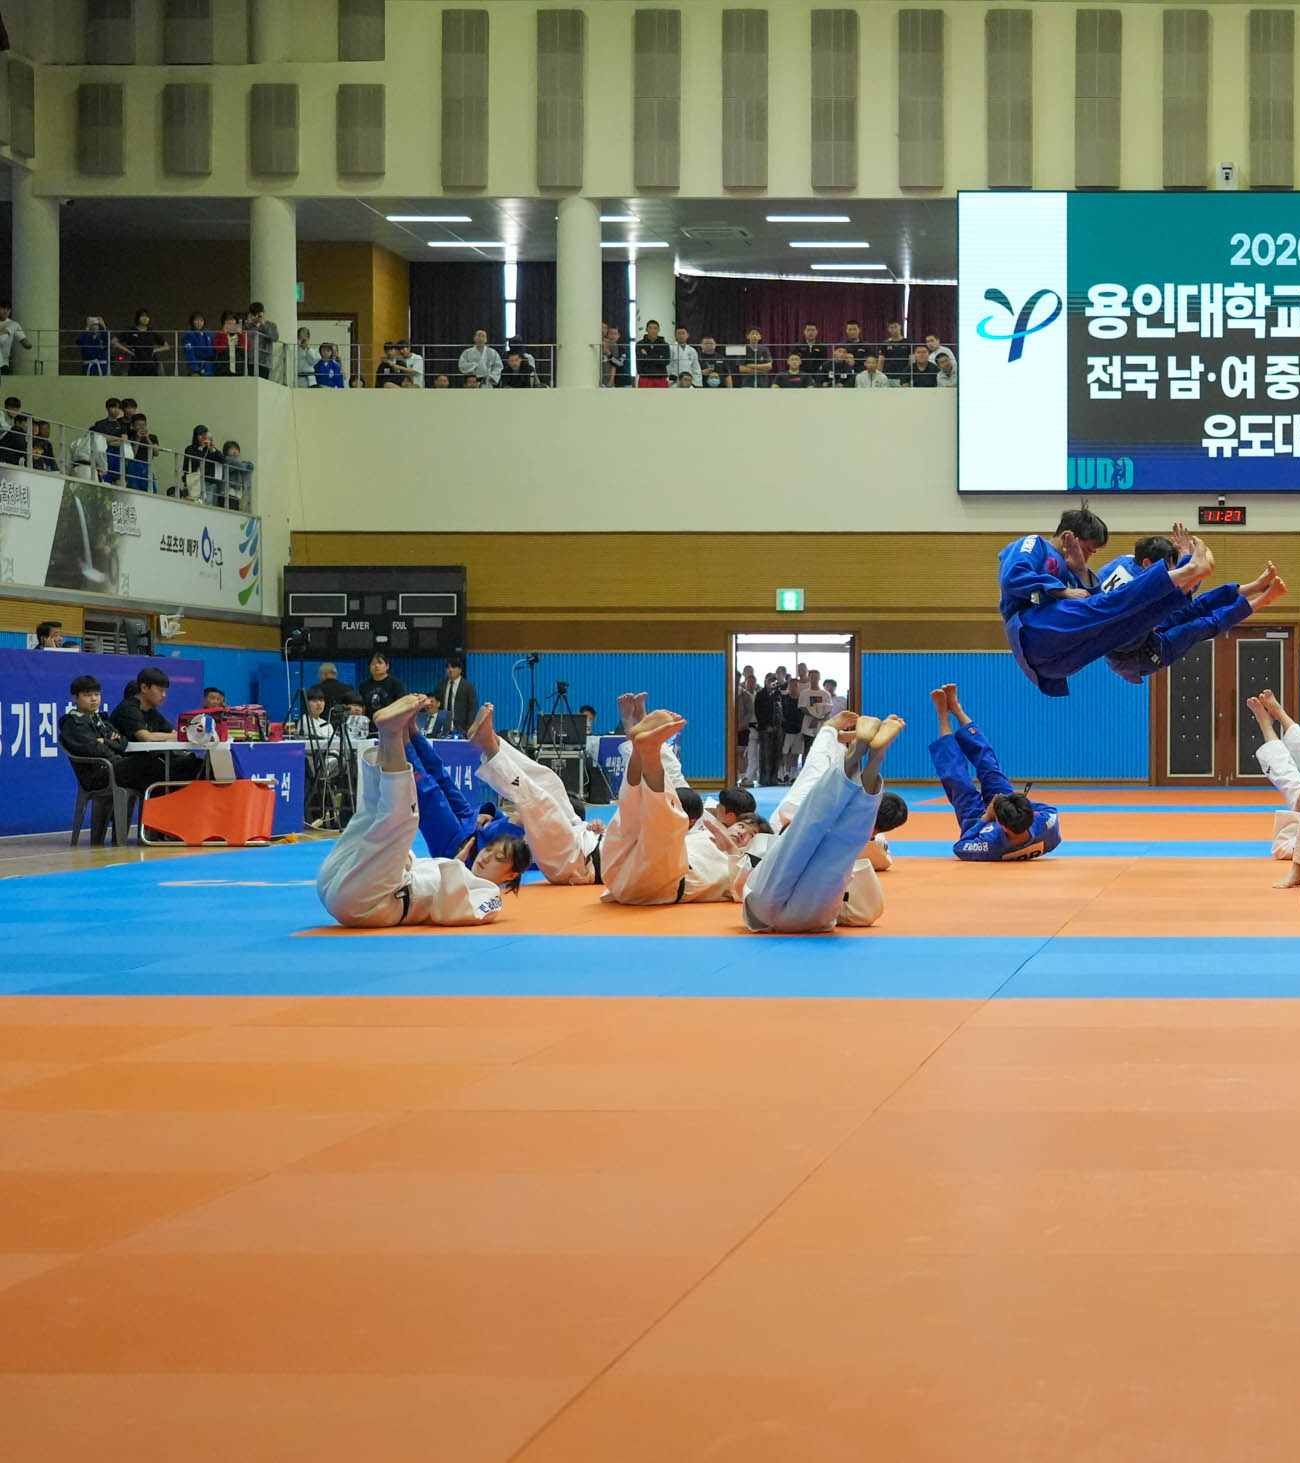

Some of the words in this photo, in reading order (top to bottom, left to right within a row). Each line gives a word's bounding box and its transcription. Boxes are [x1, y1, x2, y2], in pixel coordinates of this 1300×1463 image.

[1086, 355, 1159, 400] 전국
[1167, 355, 1256, 400] 남·여
[1208, 510, 1242, 522] 11:27
[160, 534, 185, 556] 스포츠의
[186, 538, 199, 558] 메카
[341, 621, 370, 631] PLAYER
[392, 621, 408, 631] FOUL
